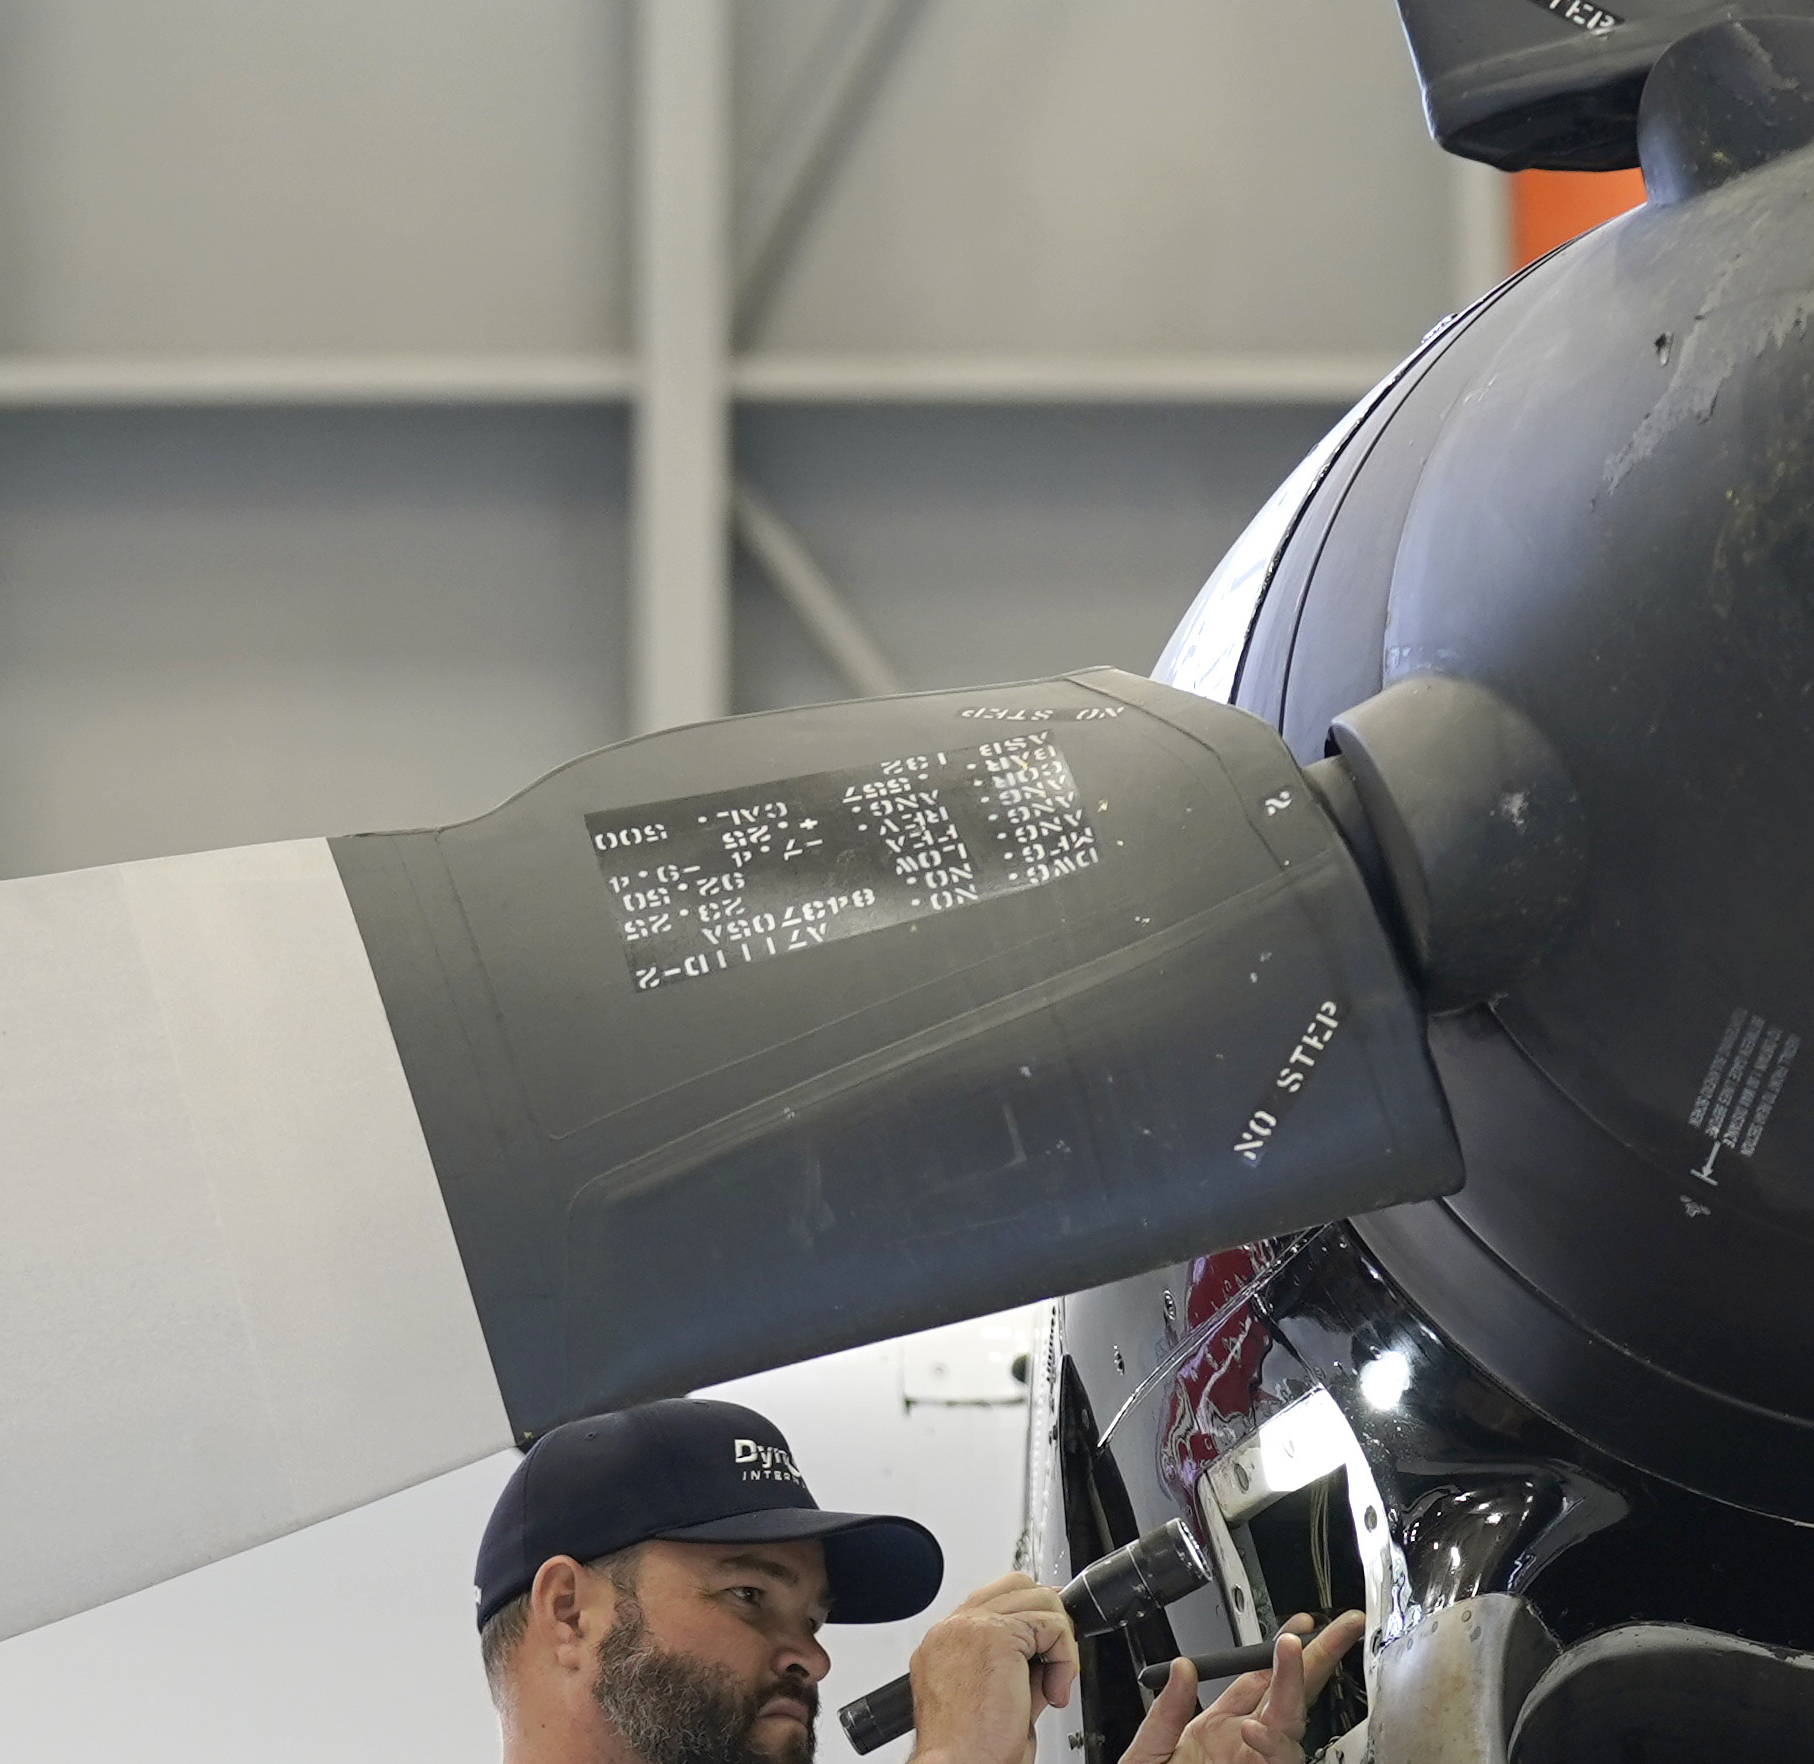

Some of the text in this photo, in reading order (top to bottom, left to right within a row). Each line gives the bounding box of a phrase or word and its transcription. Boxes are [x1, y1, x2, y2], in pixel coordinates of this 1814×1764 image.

[880, 731, 1048, 775] ASB 132
[961, 706, 1125, 721] NO STEP
[594, 745, 1057, 851] BAR. .557 CAL. 500
[851, 788, 939, 817] ANG.
[973, 760, 1063, 789] COR.
[609, 774, 1066, 894] ANG. REV. -7.4 -9.4
[622, 791, 1075, 912] ANG. FEA 92.50
[624, 809, 1082, 942] ANG. LOW 23.25
[701, 827, 1094, 945] MFG. NO. 843705A
[635, 847, 1099, 989] DWG. NO. A7111D-2
[1233, 1000, 1339, 1161] NO STEP
